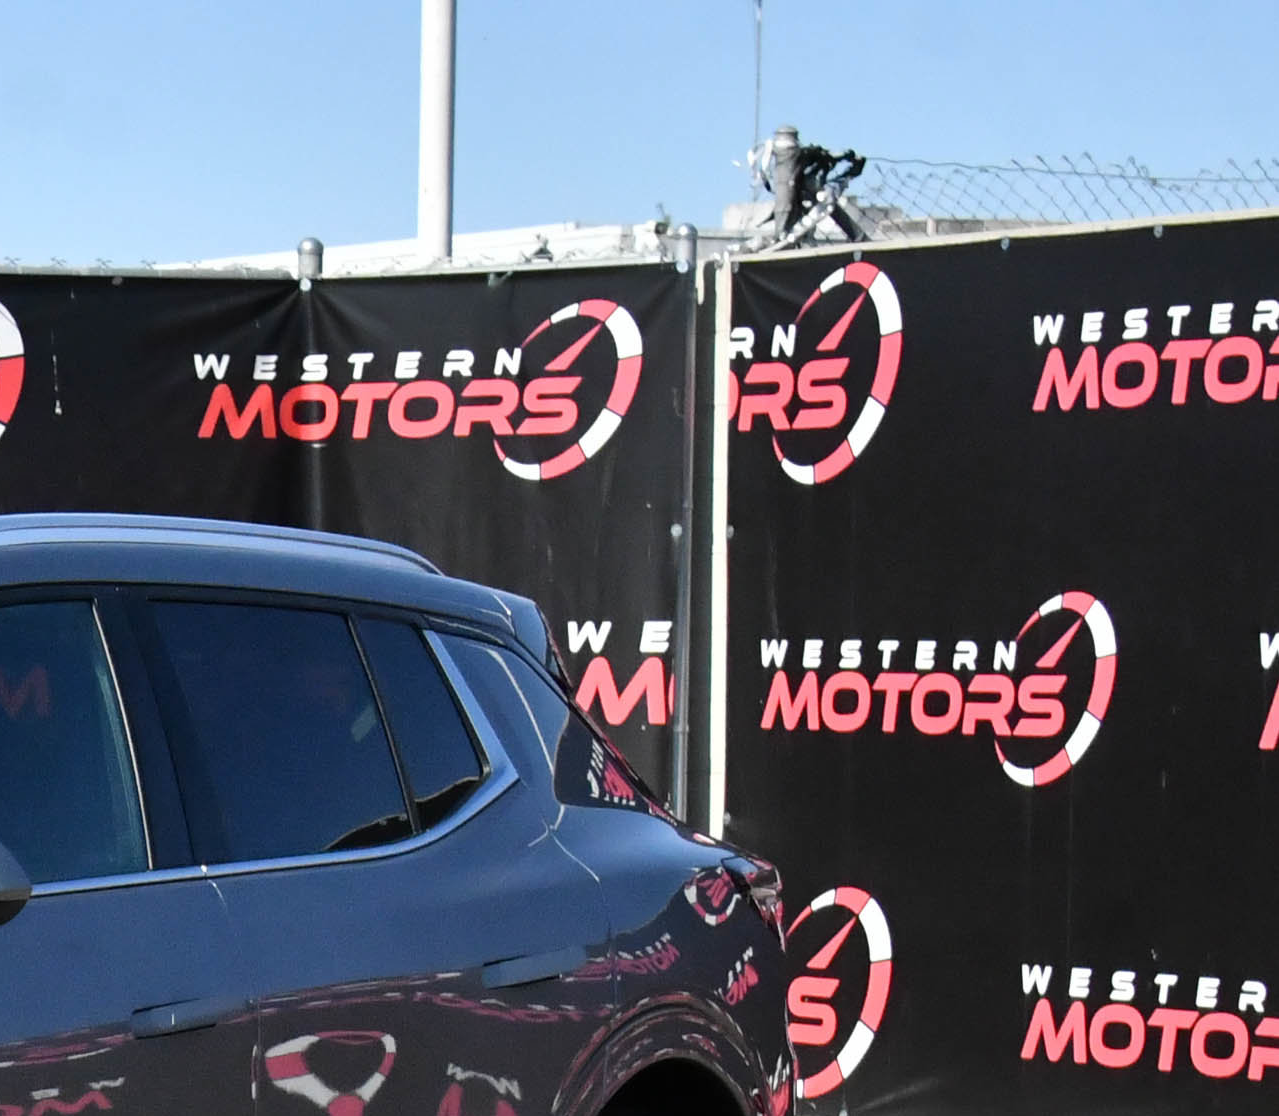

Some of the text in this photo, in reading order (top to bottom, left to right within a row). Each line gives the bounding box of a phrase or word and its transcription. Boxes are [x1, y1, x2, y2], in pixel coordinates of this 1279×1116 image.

[194, 348, 522, 381] WESTERN
[198, 376, 582, 441] MOTORS
[761, 639, 1017, 671] WESTERN
[761, 670, 1068, 737] MOTORS
